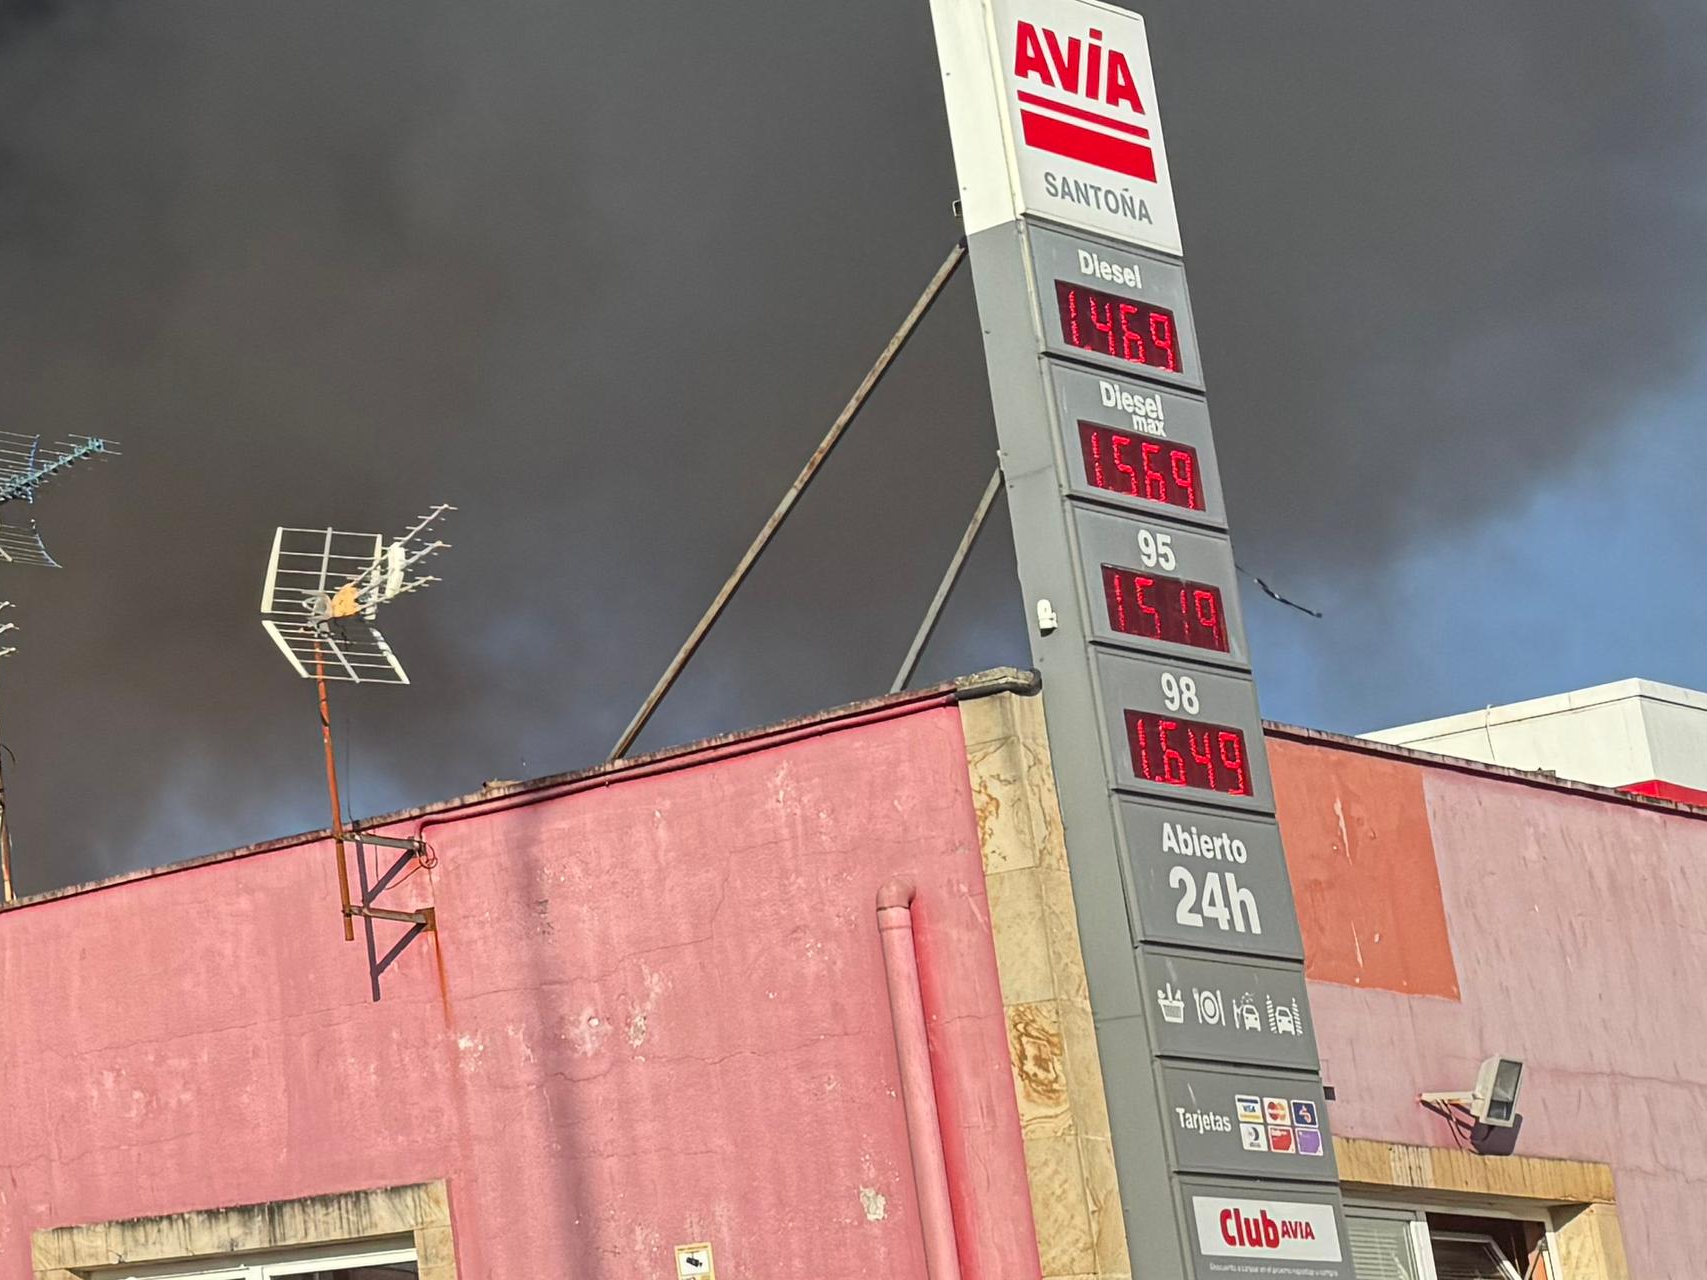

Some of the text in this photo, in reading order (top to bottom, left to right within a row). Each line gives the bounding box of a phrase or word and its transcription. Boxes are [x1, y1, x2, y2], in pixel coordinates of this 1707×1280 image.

[1044, 172, 1153, 224] SANTOÑA
[1077, 249, 1142, 288] Diesel
[1099, 380, 1164, 420] Diesel
[1132, 414, 1167, 437] max
[1138, 529, 1176, 571] 95
[1161, 672, 1200, 715] 98
[1162, 822, 1247, 863] Abierto
[1169, 865, 1262, 934] 24h
[1175, 1107, 1232, 1134] Tarjetas
[1219, 1208, 1315, 1248] Club AVIA
